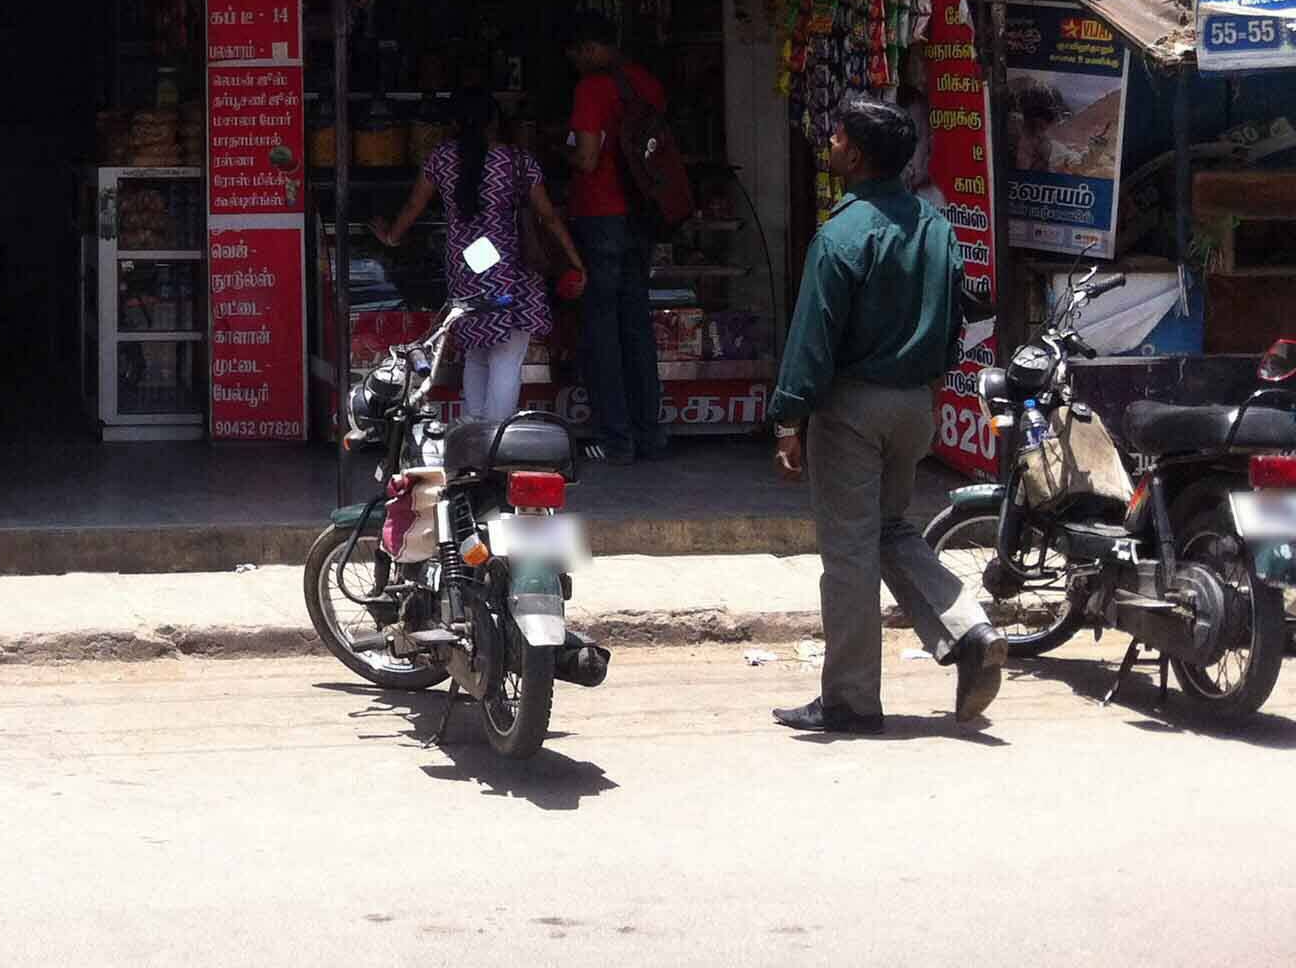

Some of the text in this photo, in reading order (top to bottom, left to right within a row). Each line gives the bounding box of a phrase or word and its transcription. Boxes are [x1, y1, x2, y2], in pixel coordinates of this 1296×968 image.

[272, 7, 289, 24] 14
[929, 108, 983, 129] முறுக்கு
[954, 176, 985, 195] காபி
[211, 240, 248, 260] வெஜ்
[214, 324, 272, 345] காளான்
[215, 420, 256, 436] 90432
